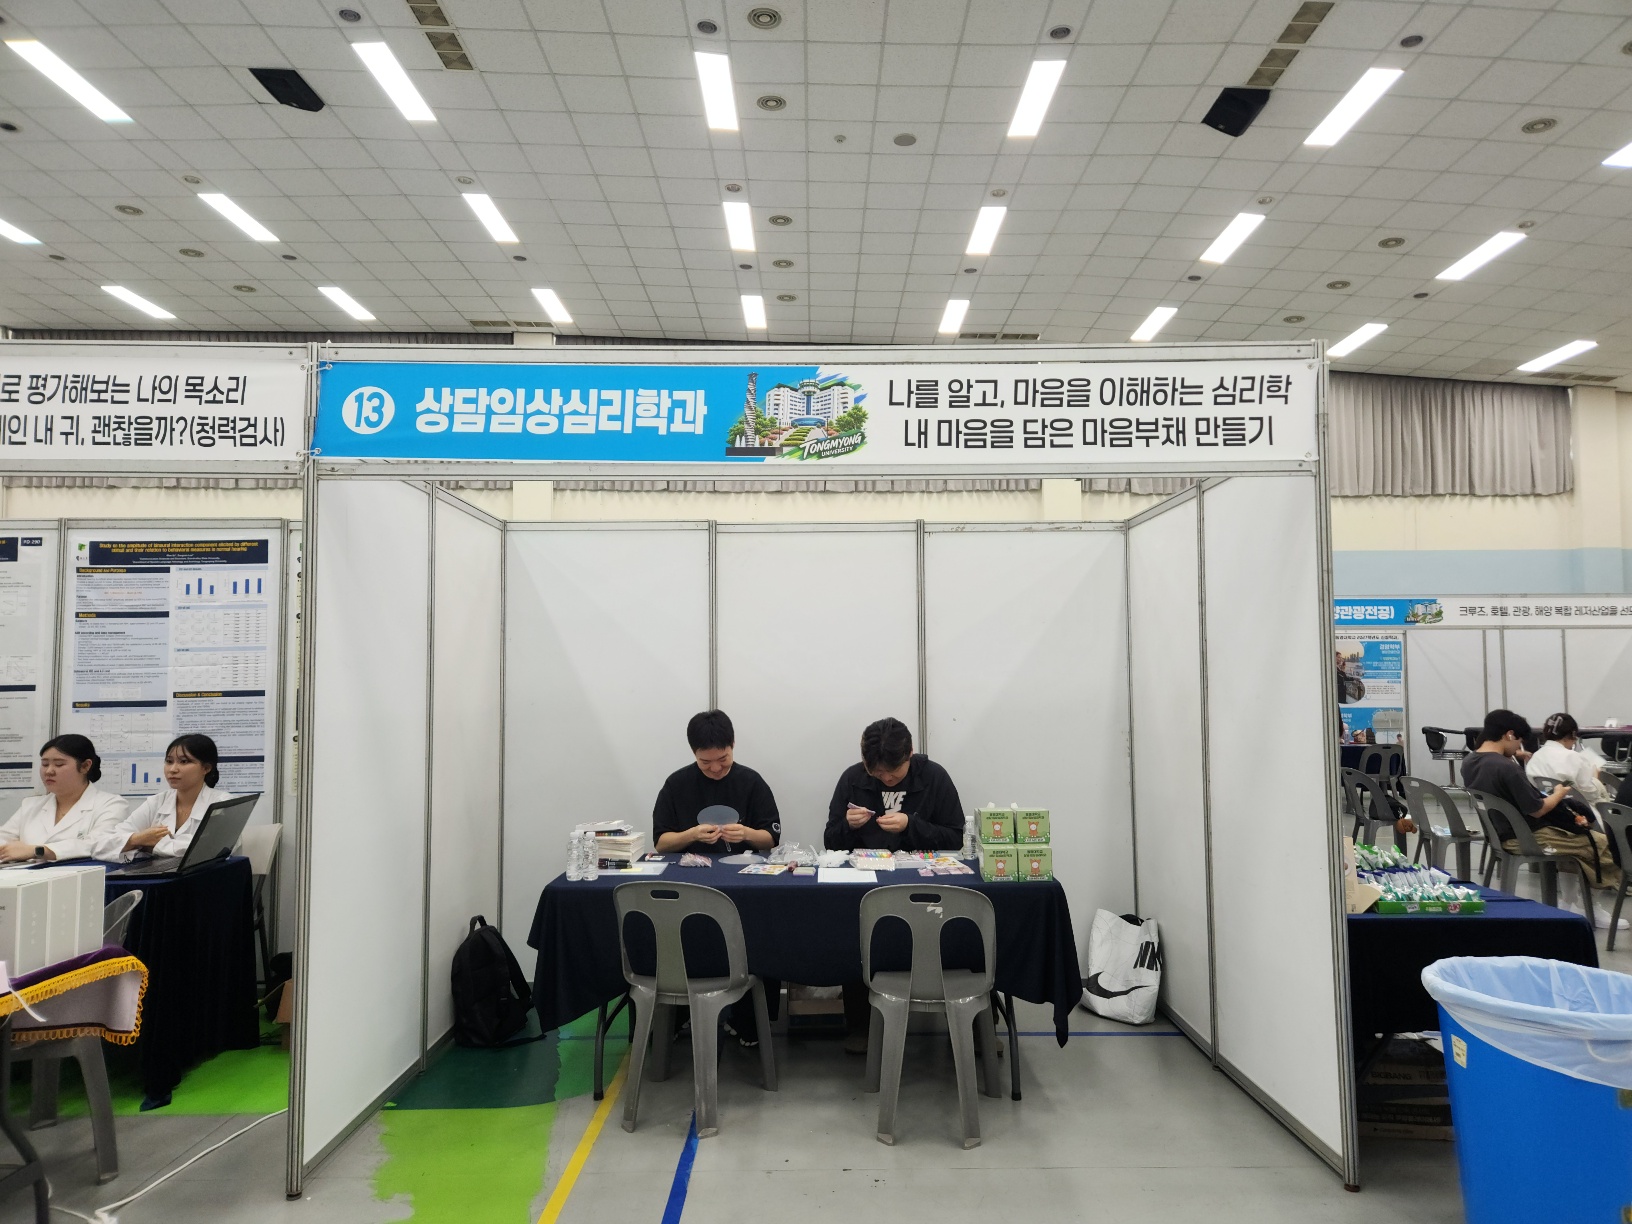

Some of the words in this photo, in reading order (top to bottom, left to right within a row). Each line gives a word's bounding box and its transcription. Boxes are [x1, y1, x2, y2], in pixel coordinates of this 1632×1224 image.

[0, 375, 21, 403] 로
[27, 374, 130, 404] 평가해보는
[136, 375, 179, 405] 나의
[184, 376, 247, 405] 목소리
[889, 379, 939, 408] 나를
[948, 379, 1005, 408] 알고,
[1014, 378, 1091, 408] 마음을
[1100, 377, 1203, 406] 이해하는
[1212, 375, 1292, 405] 심리학
[415, 387, 708, 435] 상담임상심리학과
[0, 415, 28, 446] 인
[34, 415, 54, 446] 내
[60, 415, 85, 446] 귀,
[91, 415, 285, 447] 괜찮을까?(청력검사)
[800, 432, 862, 459] TONGMYONG
[904, 419, 928, 448] 내
[937, 419, 1015, 448] 마음을
[1023, 419, 1073, 448] 담은
[1083, 417, 1186, 447] 마음부채
[1196, 416, 1273, 446] 만들기
[821, 446, 854, 457] UNIVERSITY
[1459, 606, 1489, 617] 크루즈,
[1513, 606, 1533, 617] 관광,
